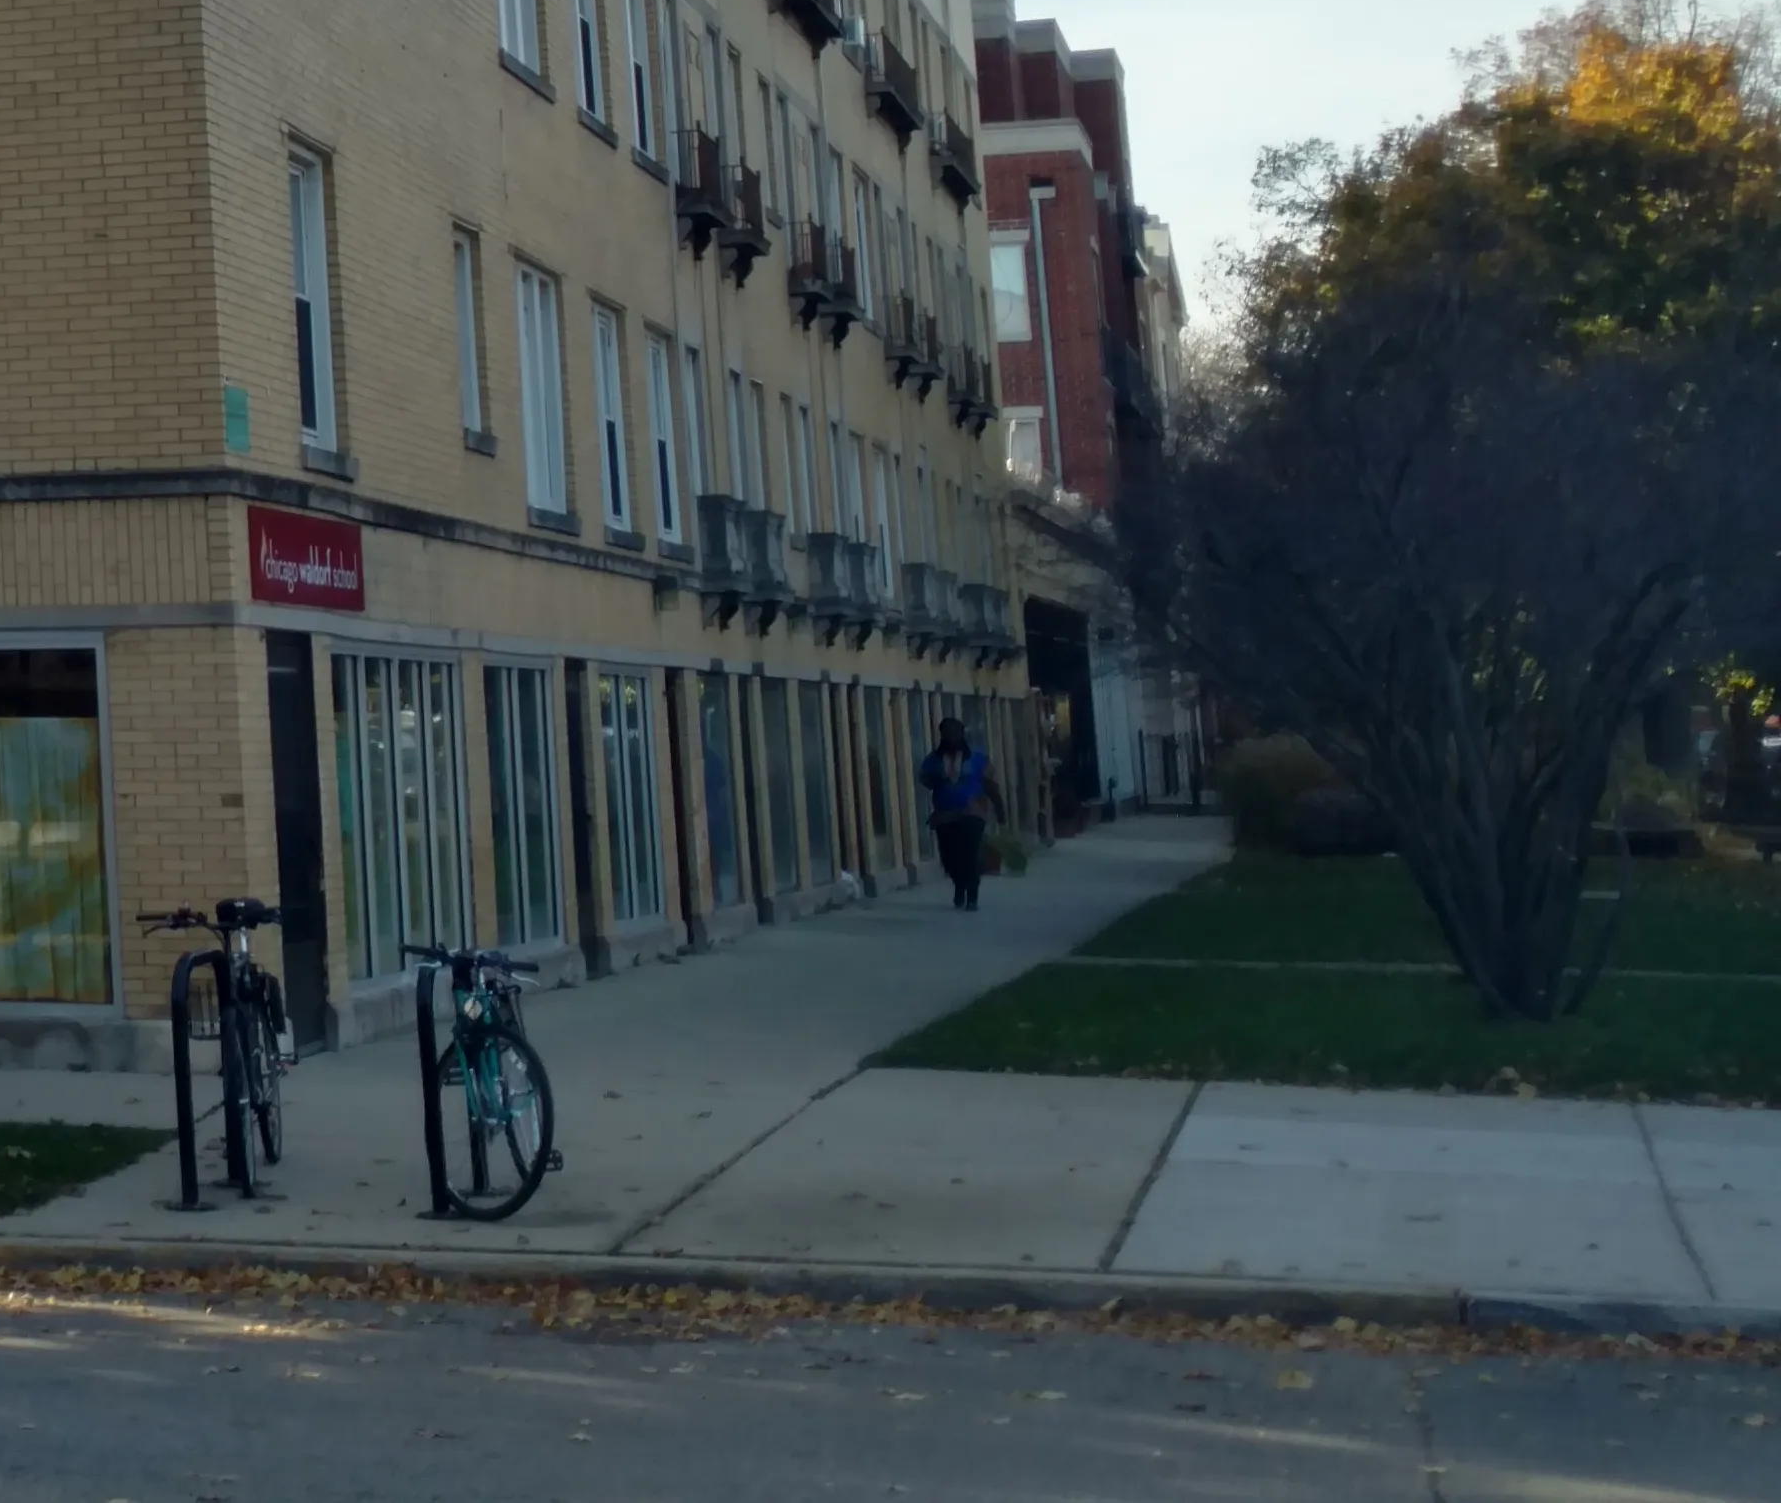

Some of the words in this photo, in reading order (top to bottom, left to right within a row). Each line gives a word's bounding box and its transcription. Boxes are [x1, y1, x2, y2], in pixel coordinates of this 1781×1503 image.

[265, 538, 298, 593] chicago
[299, 544, 331, 586] waldorf
[333, 549, 358, 590] school
